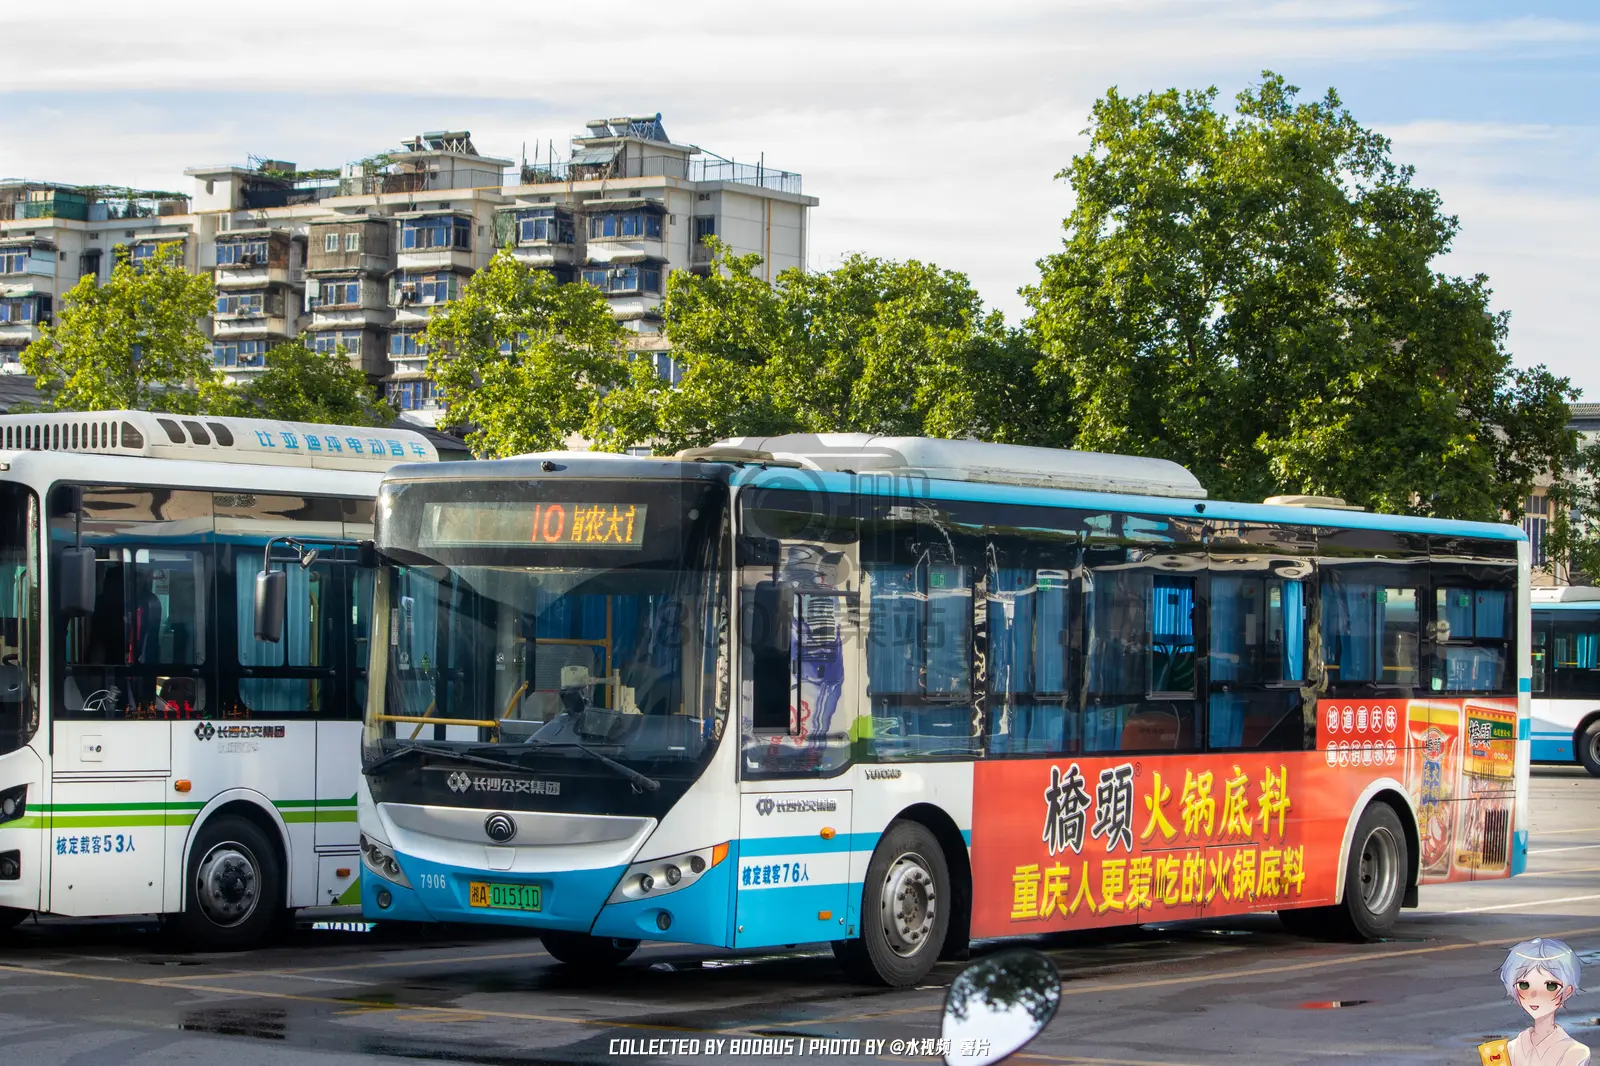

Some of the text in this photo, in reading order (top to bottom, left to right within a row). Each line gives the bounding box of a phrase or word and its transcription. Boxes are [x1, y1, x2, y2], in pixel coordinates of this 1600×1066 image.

[1326, 705, 1398, 734] 地道重庆味
[472, 777, 560, 796] 长沙公交集团
[1140, 764, 1292, 844] 火锅底料
[56, 834, 136, 856] 核定载客53人
[420, 873, 447, 889] 7906
[742, 861, 809, 886] 核定载客76人
[1010, 845, 1306, 921] 重庆人更爱吃的火锅底料
